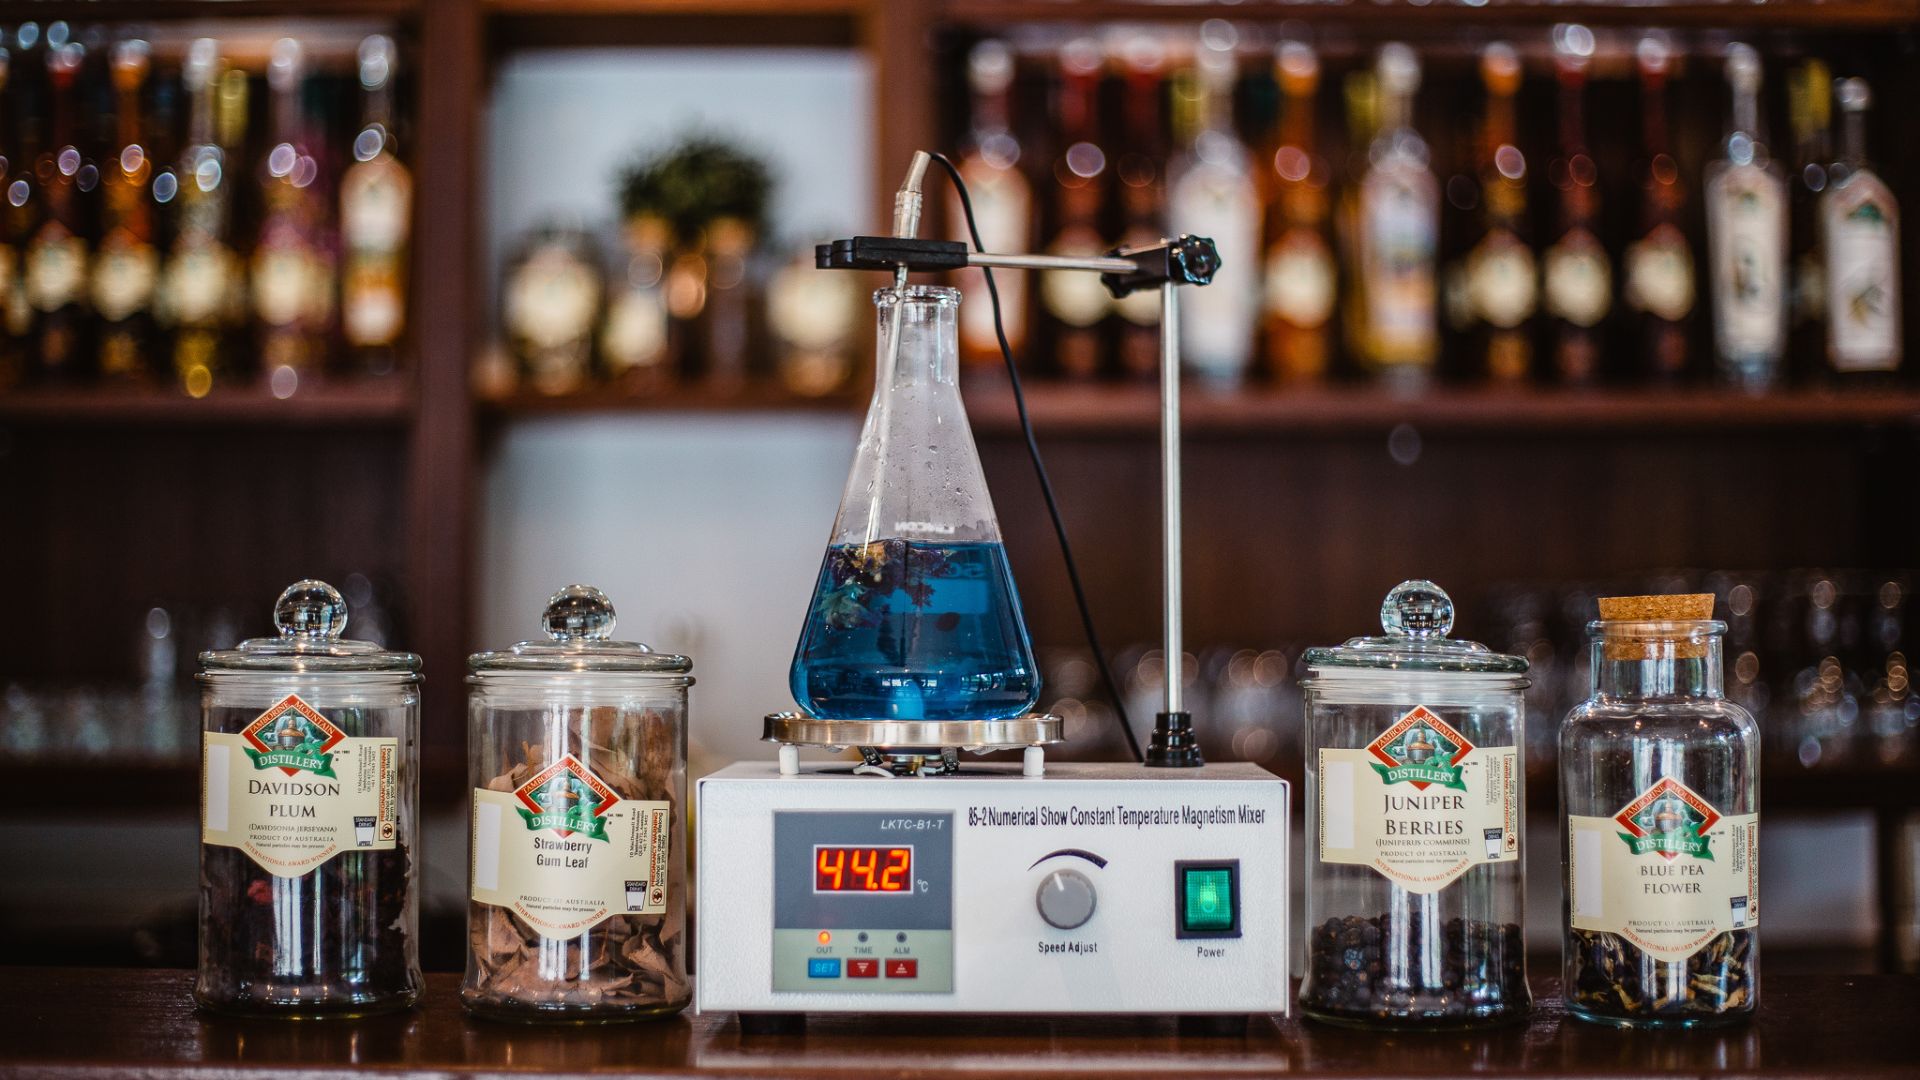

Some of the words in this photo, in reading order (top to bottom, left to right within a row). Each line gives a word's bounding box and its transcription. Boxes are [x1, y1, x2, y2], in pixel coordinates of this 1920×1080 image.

[249, 700, 290, 734] TAMBORINE
[294, 701, 335, 734] MOUNTAIN
[1375, 714, 1418, 748] TAMBORINE
[1423, 713, 1463, 746] MOUNTAIN
[259, 754, 325, 770] DISTILLERY
[522, 763, 566, 794] TAMBORINE
[569, 762, 609, 797] MOUNTAIN
[1388, 768, 1455, 782] DISTILLERY
[248, 779, 340, 796] DAVIDSON
[1384, 794, 1465, 814] JUNIPER
[1623, 785, 1665, 818] TAMBORINE
[1671, 784, 1710, 816] MOUNTAIN
[269, 804, 316, 818] PLUM
[968, 806, 987, 827] 85-2
[988, 806, 1039, 827] Numerical
[1040, 806, 1068, 826] Show
[1070, 805, 1116, 826] Constant
[1117, 805, 1180, 830] Temperature
[1182, 804, 1237, 829] Magnetism
[1238, 804, 1266, 824] Mixer
[532, 815, 598, 832] DISTILLERY
[881, 819, 945, 830] LKTC-B1-T
[1385, 819, 1464, 835] BERRIES
[534, 836, 592, 854] Strawberry
[1375, 838, 1422, 847] (JUNIPERUS
[1636, 838, 1702, 852] DISTILLERY
[244, 841, 286, 866] INTERNATIONAL
[311, 843, 337, 862] WINNERS
[536, 853, 561, 867] Gum
[565, 856, 589, 868] Leaf
[818, 849, 910, 890] 44.2
[1640, 865, 1675, 876] BLUE
[1681, 865, 1704, 876] PEA
[1644, 882, 1702, 894] FLOWER
[581, 908, 608, 926] WINNERS
[816, 946, 833, 954] OUT
[854, 946, 873, 954] TIME
[893, 946, 911, 955] ALM
[1038, 941, 1066, 953] Speed
[1068, 941, 1098, 955] Adjust
[1197, 946, 1225, 957] Power
[815, 963, 835, 973] SET
